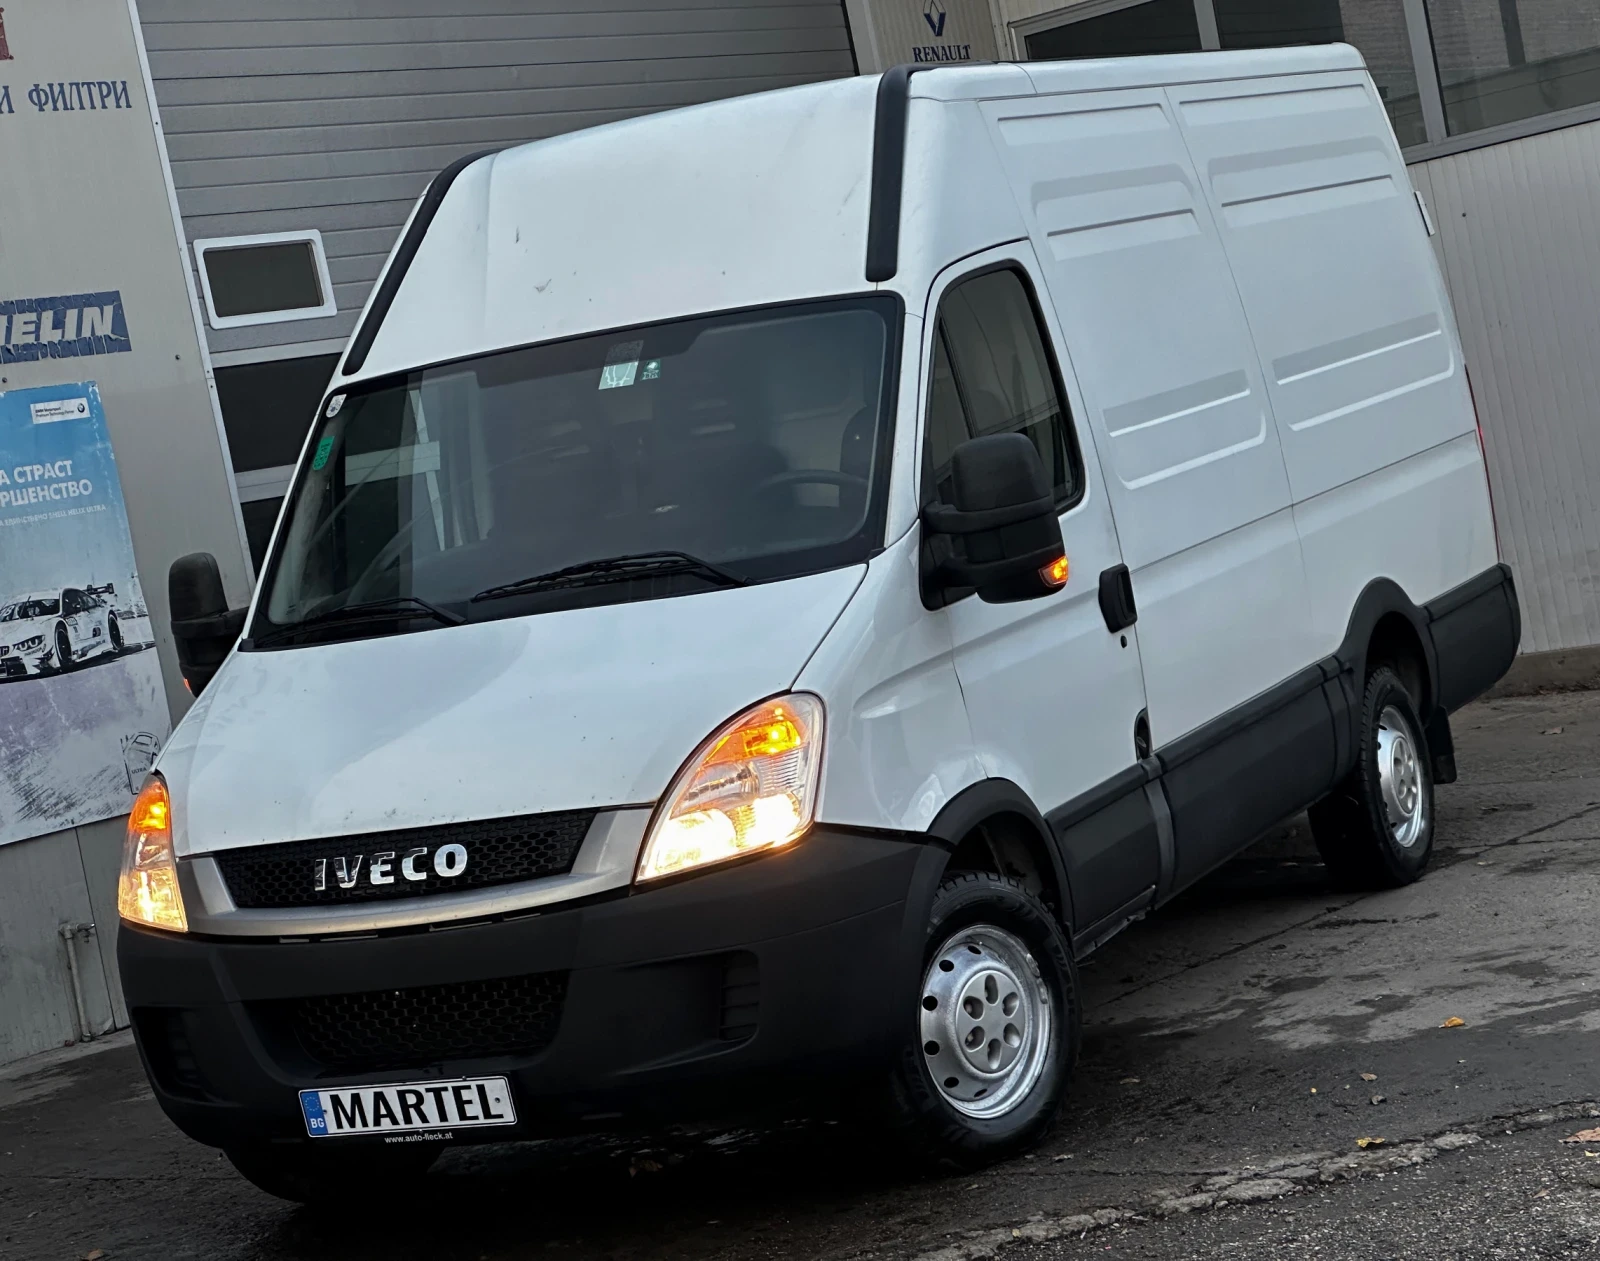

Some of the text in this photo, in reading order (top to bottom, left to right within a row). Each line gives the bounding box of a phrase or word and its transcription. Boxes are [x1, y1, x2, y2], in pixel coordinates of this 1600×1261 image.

[912, 44, 971, 62] RENAULT
[28, 80, 132, 112] ФИЛТРИ
[0, 304, 114, 346] ELIN
[13, 460, 73, 484] СТРАСТ
[0, 479, 93, 508] РШЕНСТВО
[86, 504, 107, 513] ULTRA
[131, 767, 147, 775] ULTRA
[314, 843, 468, 891] IVECO
[310, 1083, 504, 1129] BG MARTEL
